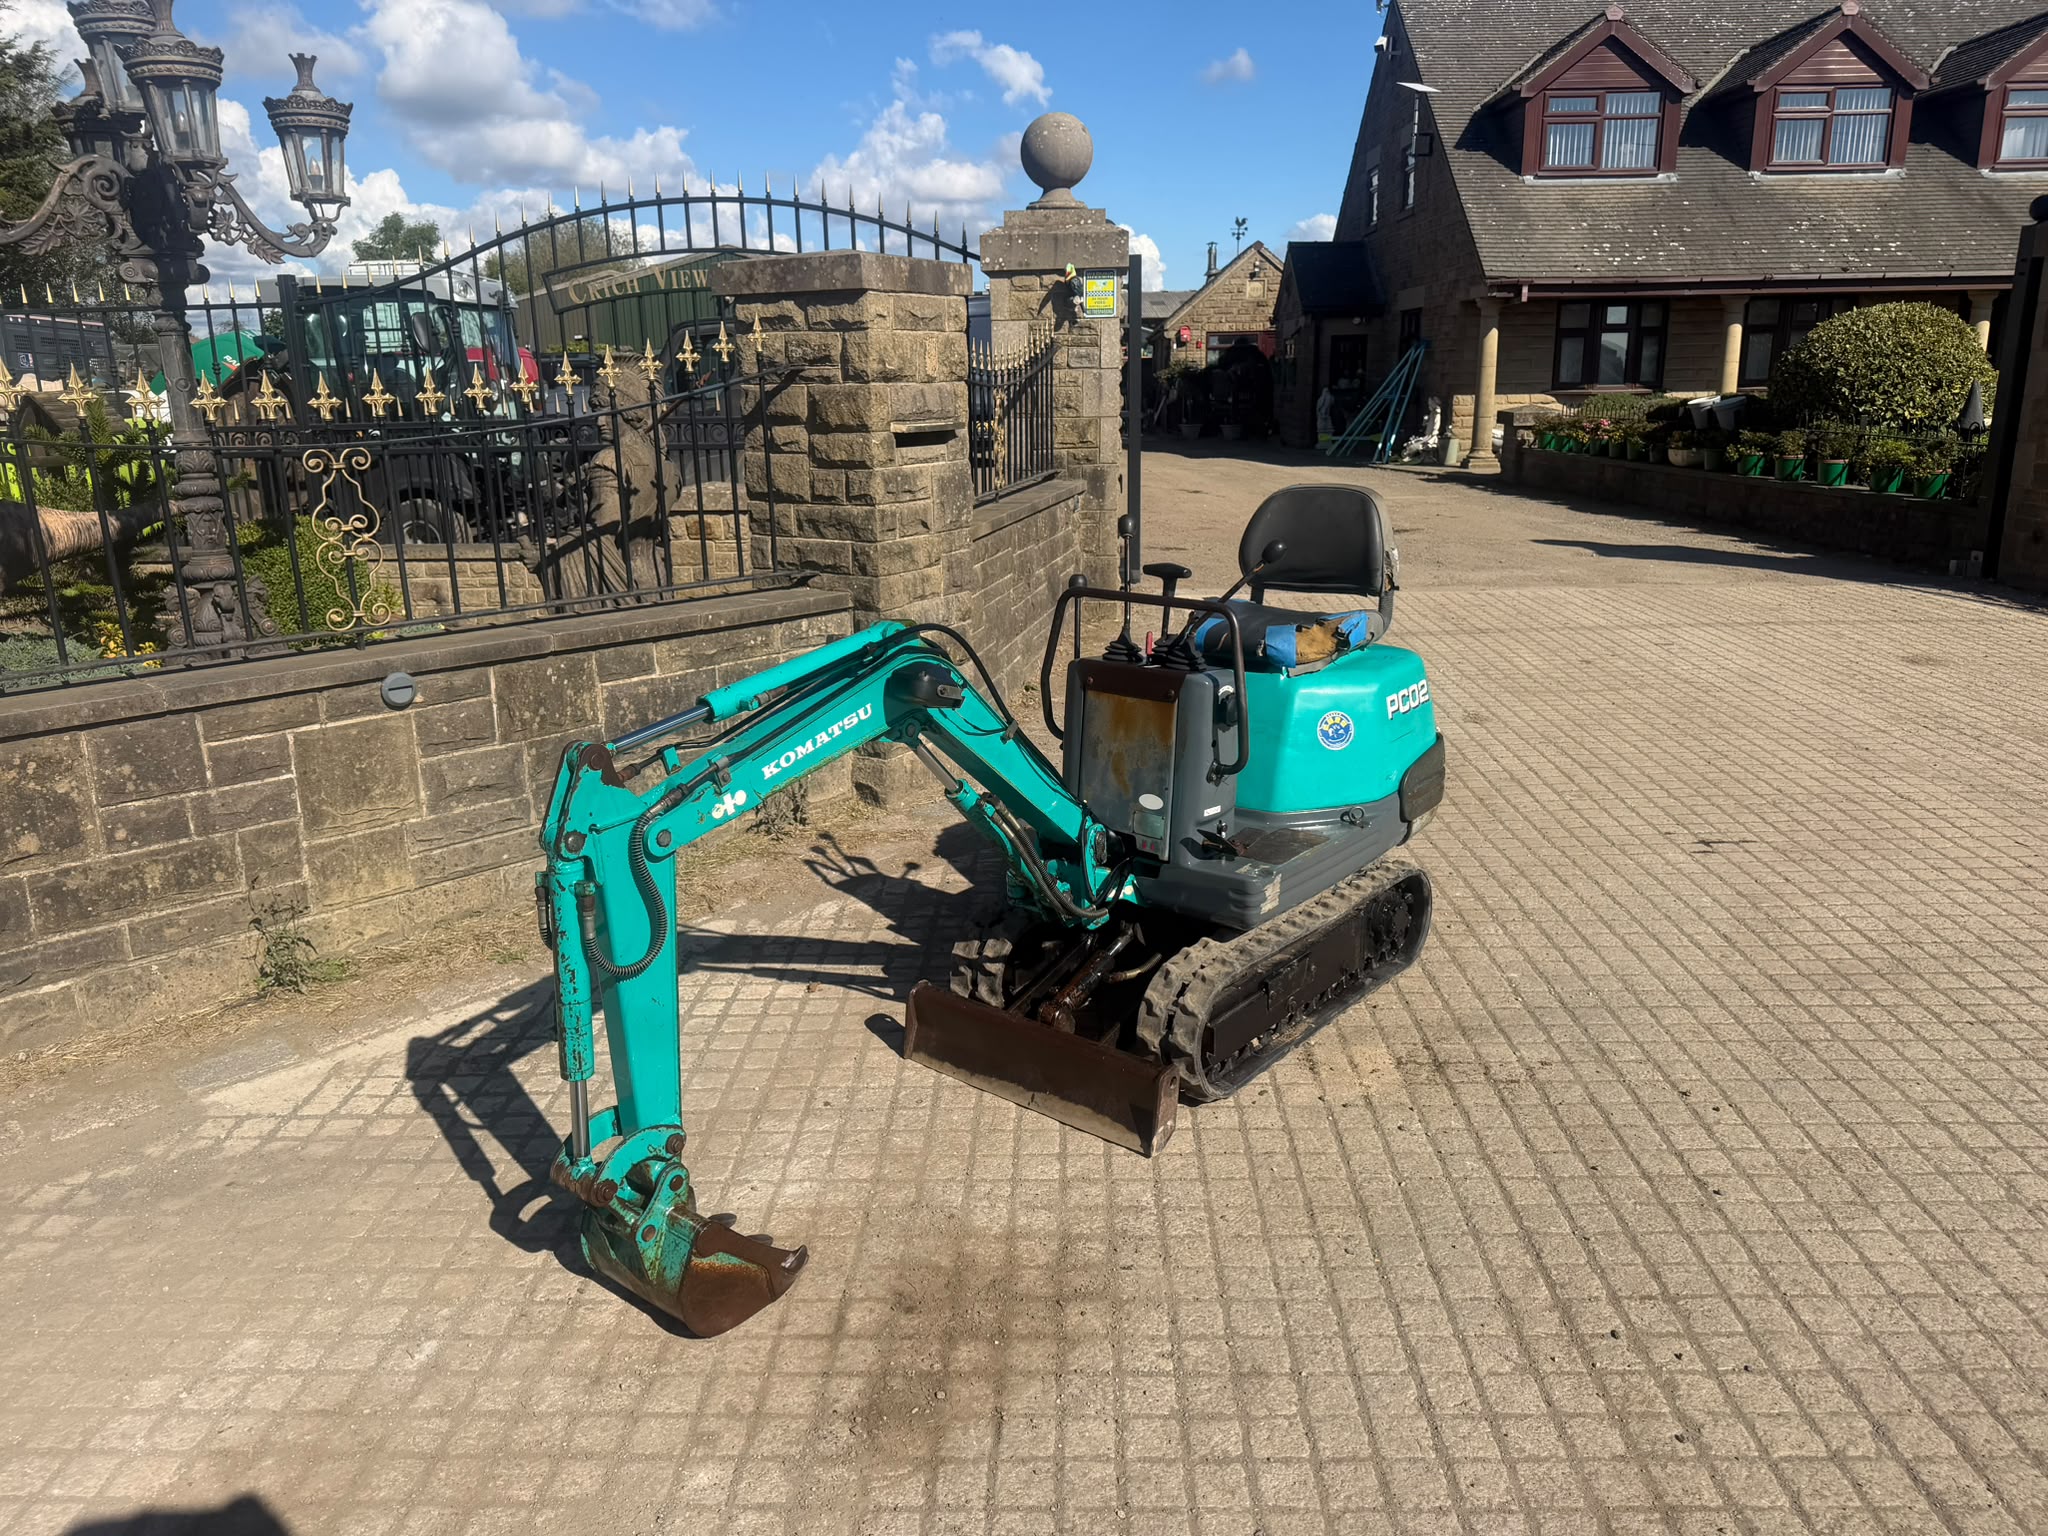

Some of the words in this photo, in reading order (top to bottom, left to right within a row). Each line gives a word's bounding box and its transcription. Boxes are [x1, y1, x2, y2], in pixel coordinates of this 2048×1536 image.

[568, 278, 640, 304] CRICH
[648, 264, 709, 289] VIEW
[1386, 679, 1430, 721] PC02
[761, 703, 872, 780] KOMATSU
